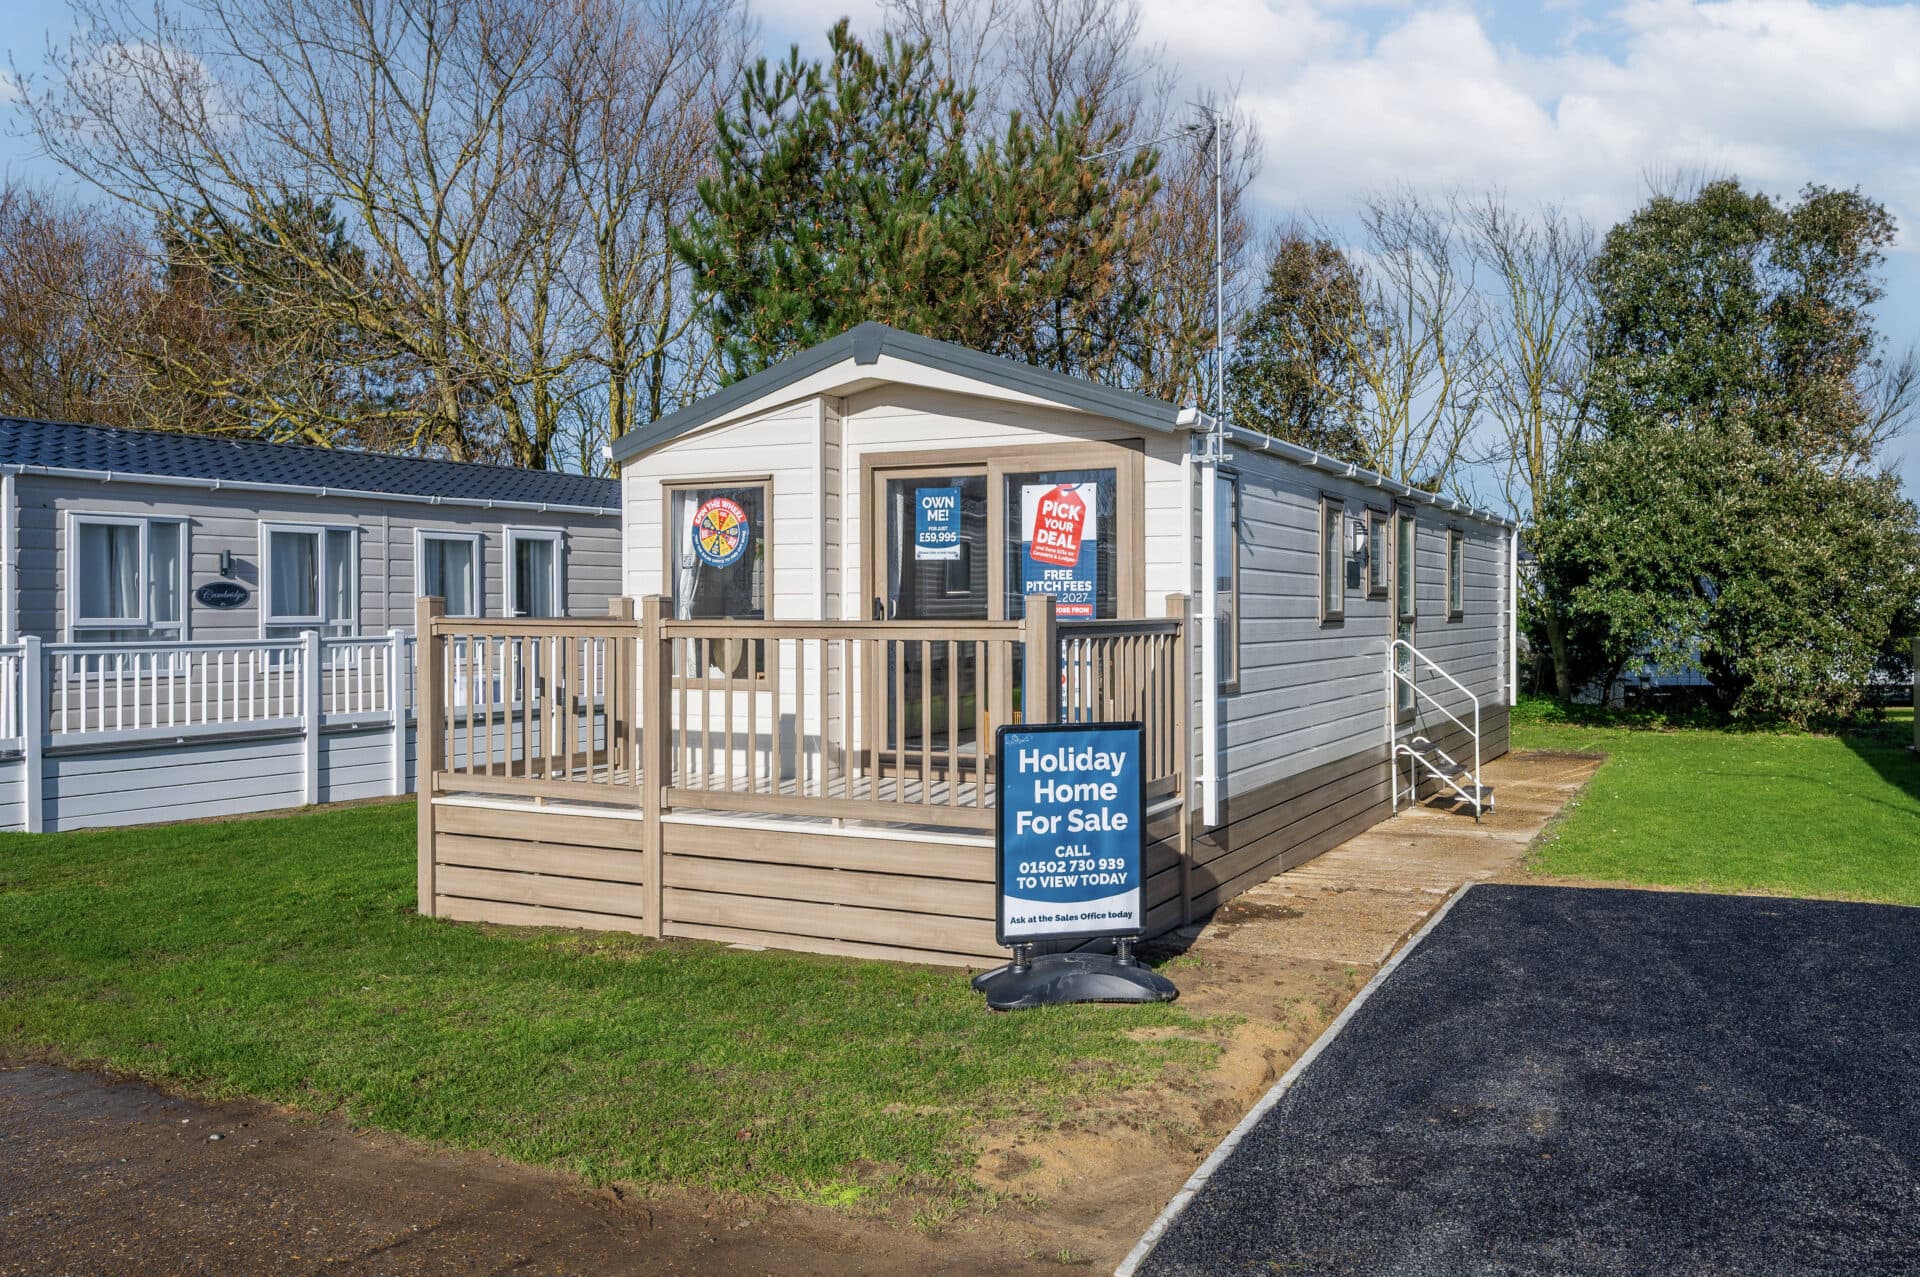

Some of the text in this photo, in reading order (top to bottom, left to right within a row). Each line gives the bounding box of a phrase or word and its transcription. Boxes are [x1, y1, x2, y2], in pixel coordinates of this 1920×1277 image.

[922, 496, 954, 509] OWN
[695, 500, 743, 524] SPIN THE WHEEL
[927, 509, 949, 522] ME!
[1042, 500, 1081, 522] PICK
[1045, 518, 1073, 532] YOUR
[919, 532, 956, 543] £59,995
[1037, 529, 1076, 550] DEAL
[1044, 569, 1073, 580] FREE
[1026, 581, 1092, 592] PITCH FEES
[1063, 593, 1088, 603] 2027
[1019, 746, 1126, 777] Holiday
[1034, 779, 1118, 804] Home
[1016, 806, 1128, 835] For Sale
[1055, 844, 1091, 858] CALL
[1019, 858, 1125, 874] 01502 730 939
[1016, 872, 1128, 889] TO VIEW TODAY
[1010, 911, 1132, 924] Ask at the Sales Office today
